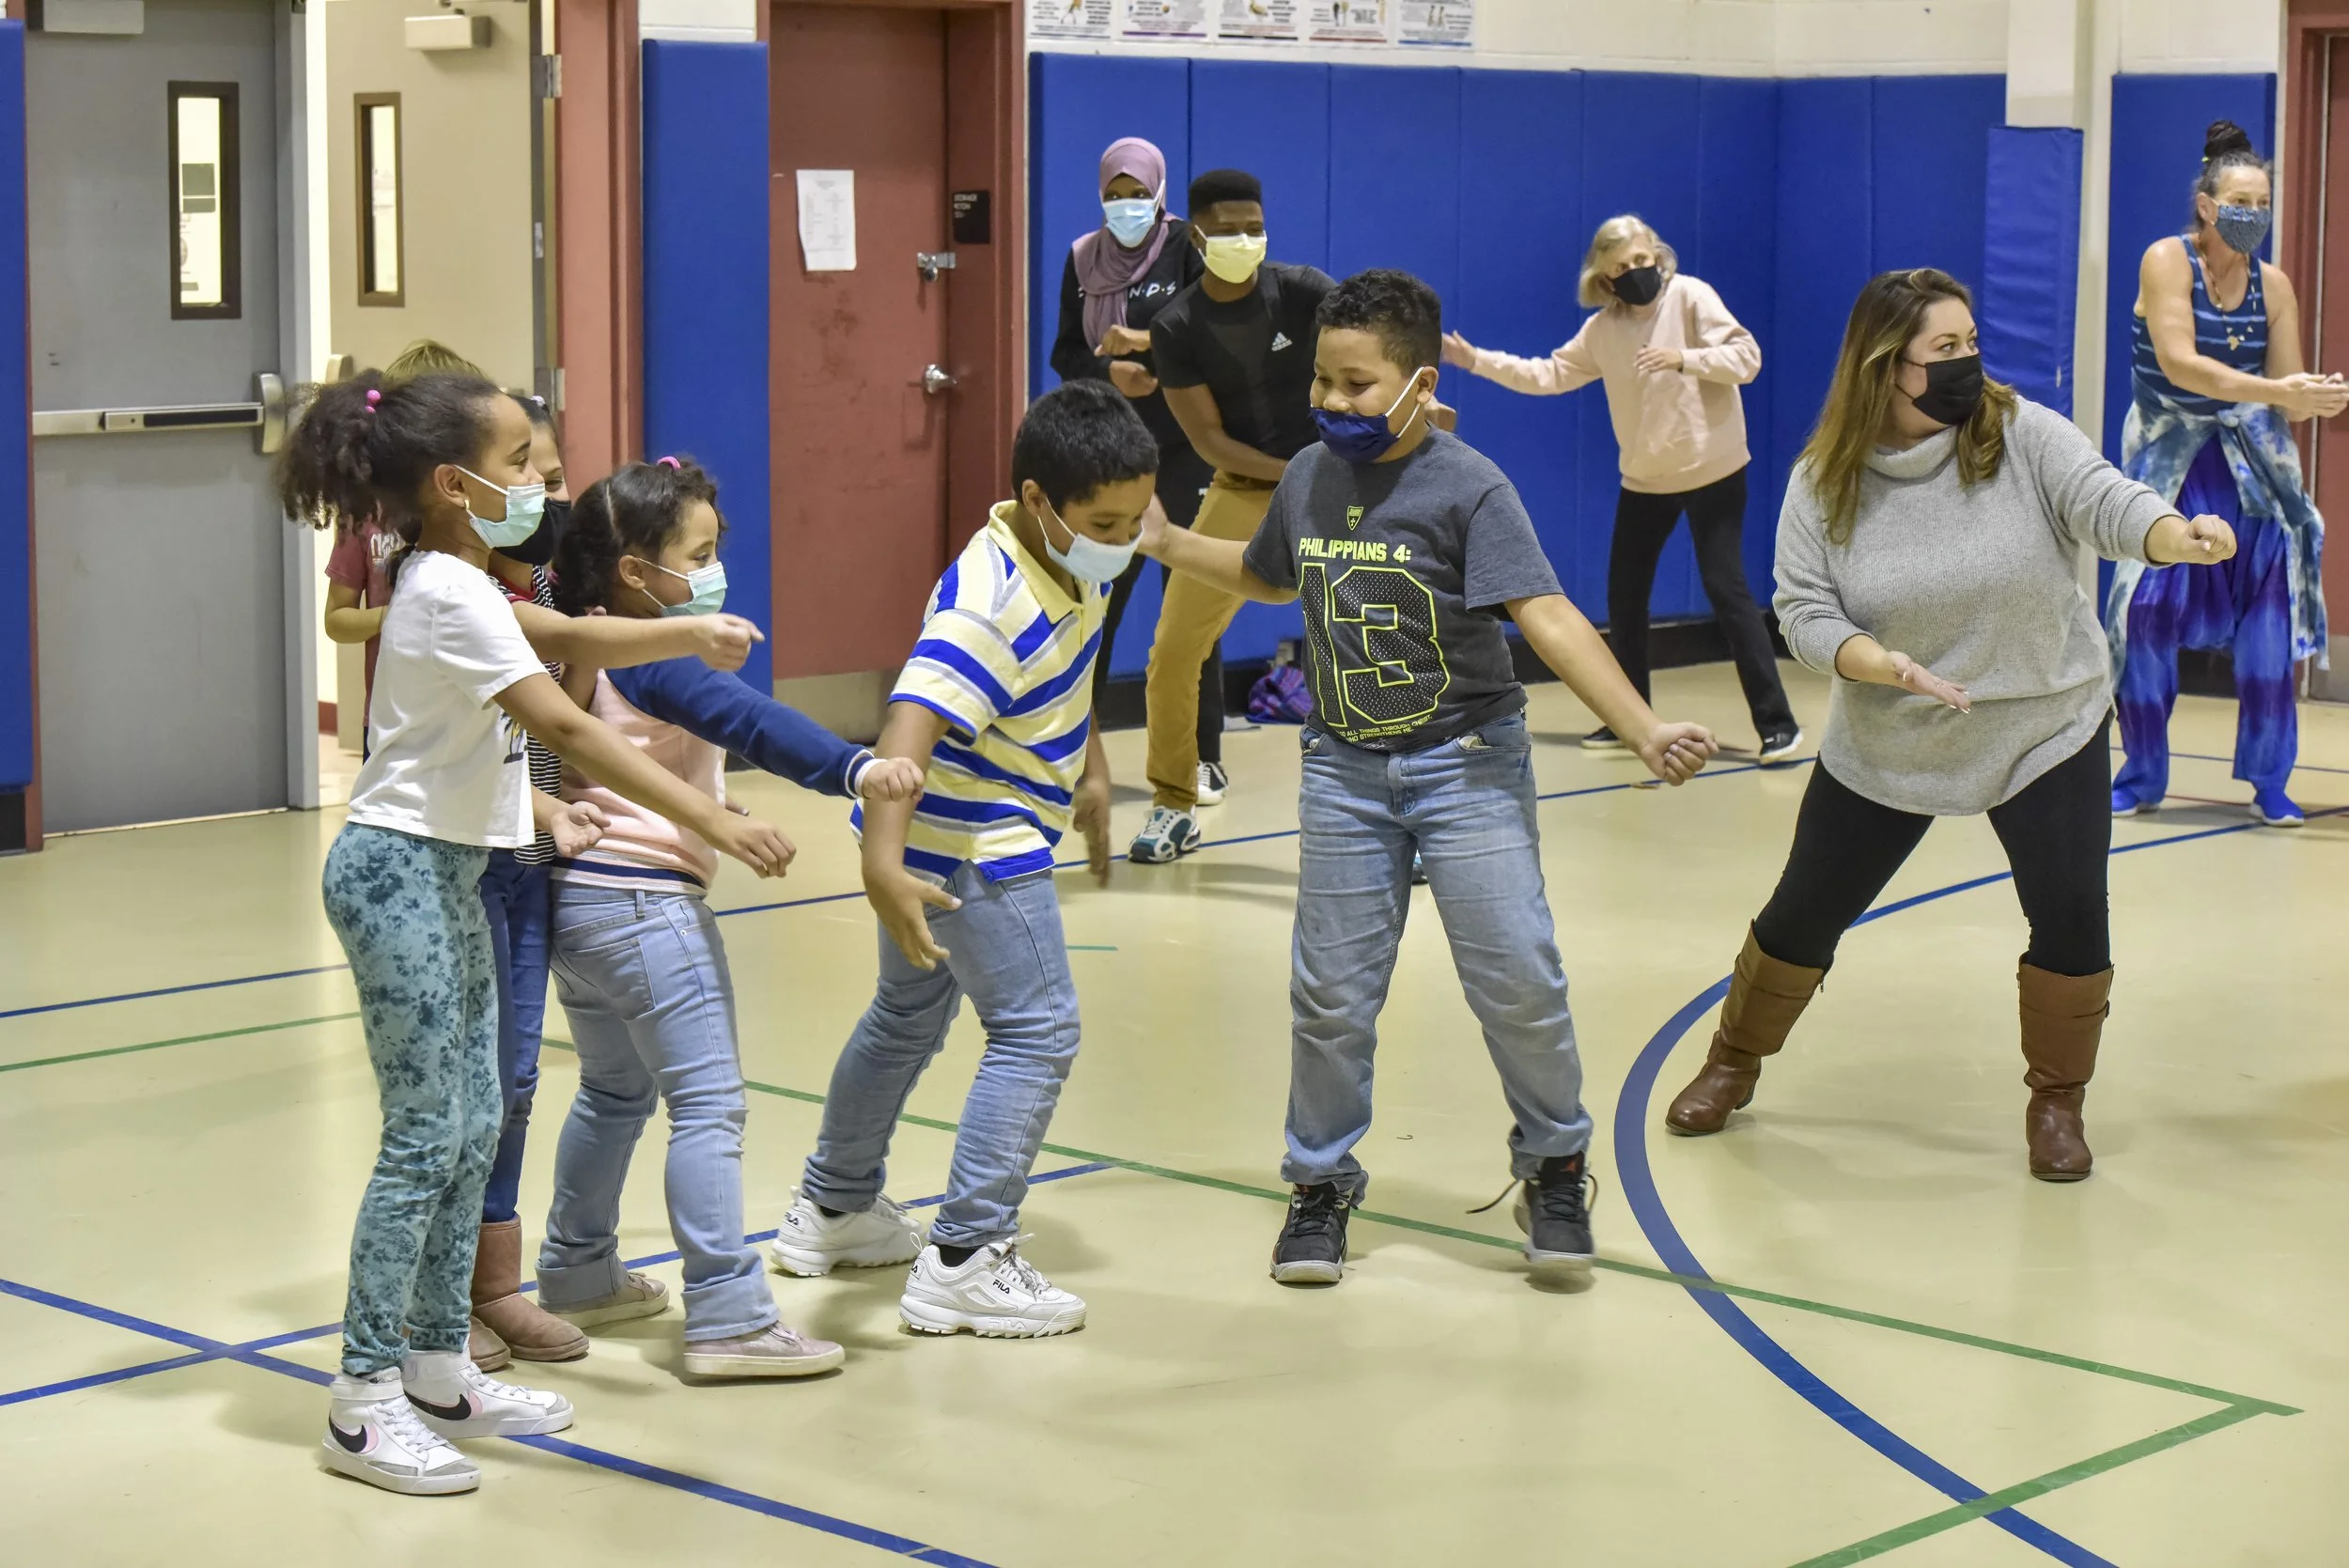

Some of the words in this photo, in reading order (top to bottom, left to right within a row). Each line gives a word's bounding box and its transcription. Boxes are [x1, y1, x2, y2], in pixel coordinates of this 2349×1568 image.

[1298, 537, 1388, 563] PHILIPPIANS
[1392, 544, 1412, 564] 4:
[1299, 562, 1451, 729] 13
[1381, 723, 1410, 732] THROUGH
[992, 1279, 1010, 1294] FILA
